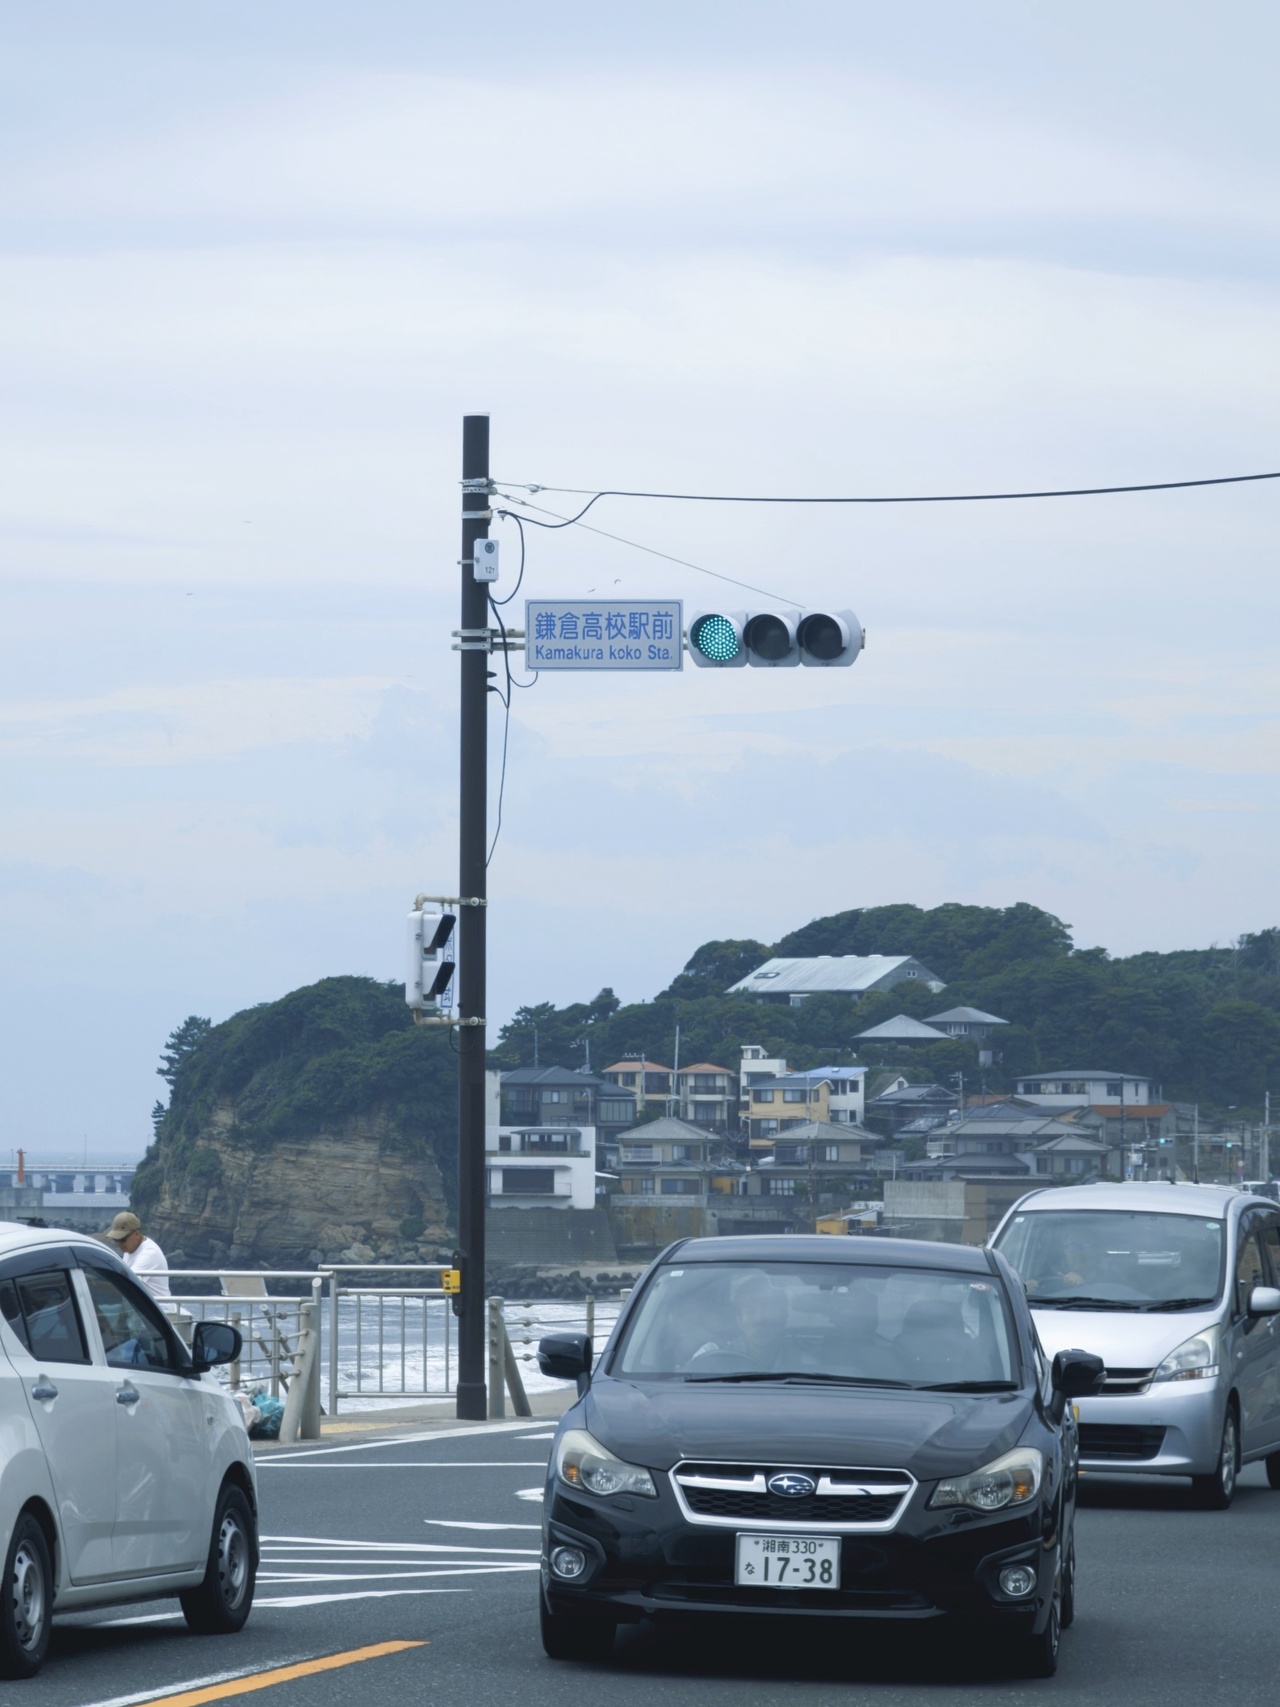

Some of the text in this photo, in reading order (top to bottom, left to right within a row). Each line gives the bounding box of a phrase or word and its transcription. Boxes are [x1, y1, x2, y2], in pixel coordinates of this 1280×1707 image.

[534, 611, 674, 640] 鎌倉高校駅前
[535, 644, 673, 660] Kamakura koko Sta.
[744, 1556, 833, 1584] な 17-38
